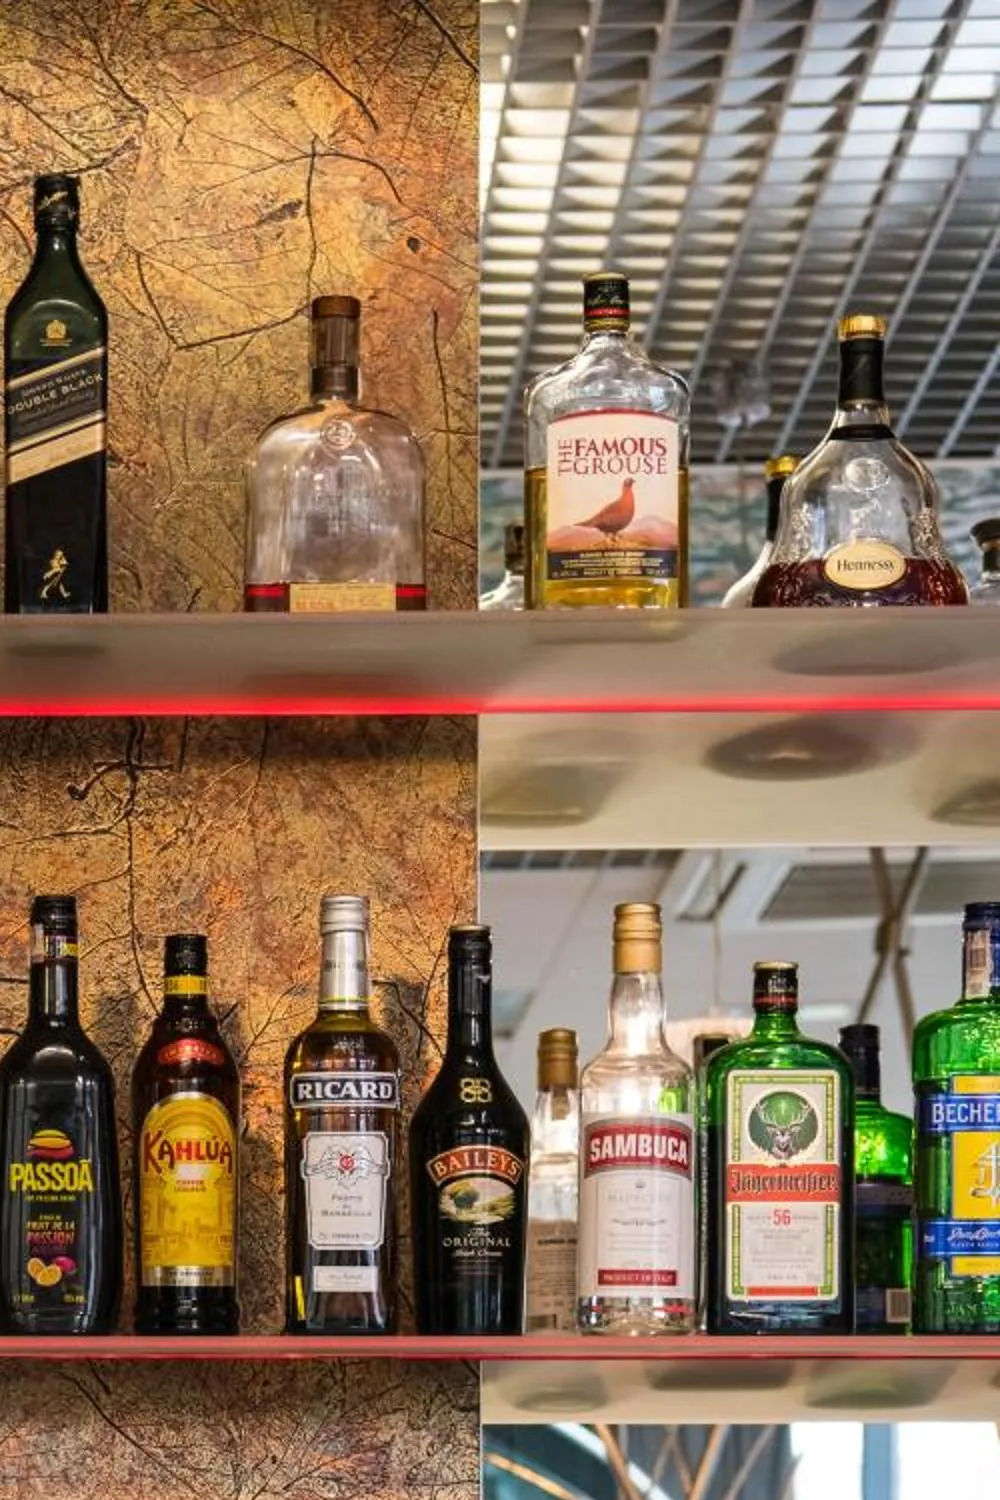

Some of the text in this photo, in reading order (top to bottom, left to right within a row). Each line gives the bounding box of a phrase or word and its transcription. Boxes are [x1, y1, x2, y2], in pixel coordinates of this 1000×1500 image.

[8, 390, 58, 415] DOUBLE
[60, 373, 103, 395] BLACK
[574, 437, 667, 457] FAMOUS
[558, 439, 572, 476] THE
[573, 457, 668, 475] GROUSE
[836, 557, 896, 573] Hennessy
[297, 1081, 393, 1100] RICARD
[144, 1130, 233, 1174] KAHLÚA
[590, 1133, 688, 1164] SAMBUCA
[434, 1150, 520, 1177] BAILEYS
[773, 1209, 792, 1226] 56
[442, 1236, 512, 1249] ORIGINAL
